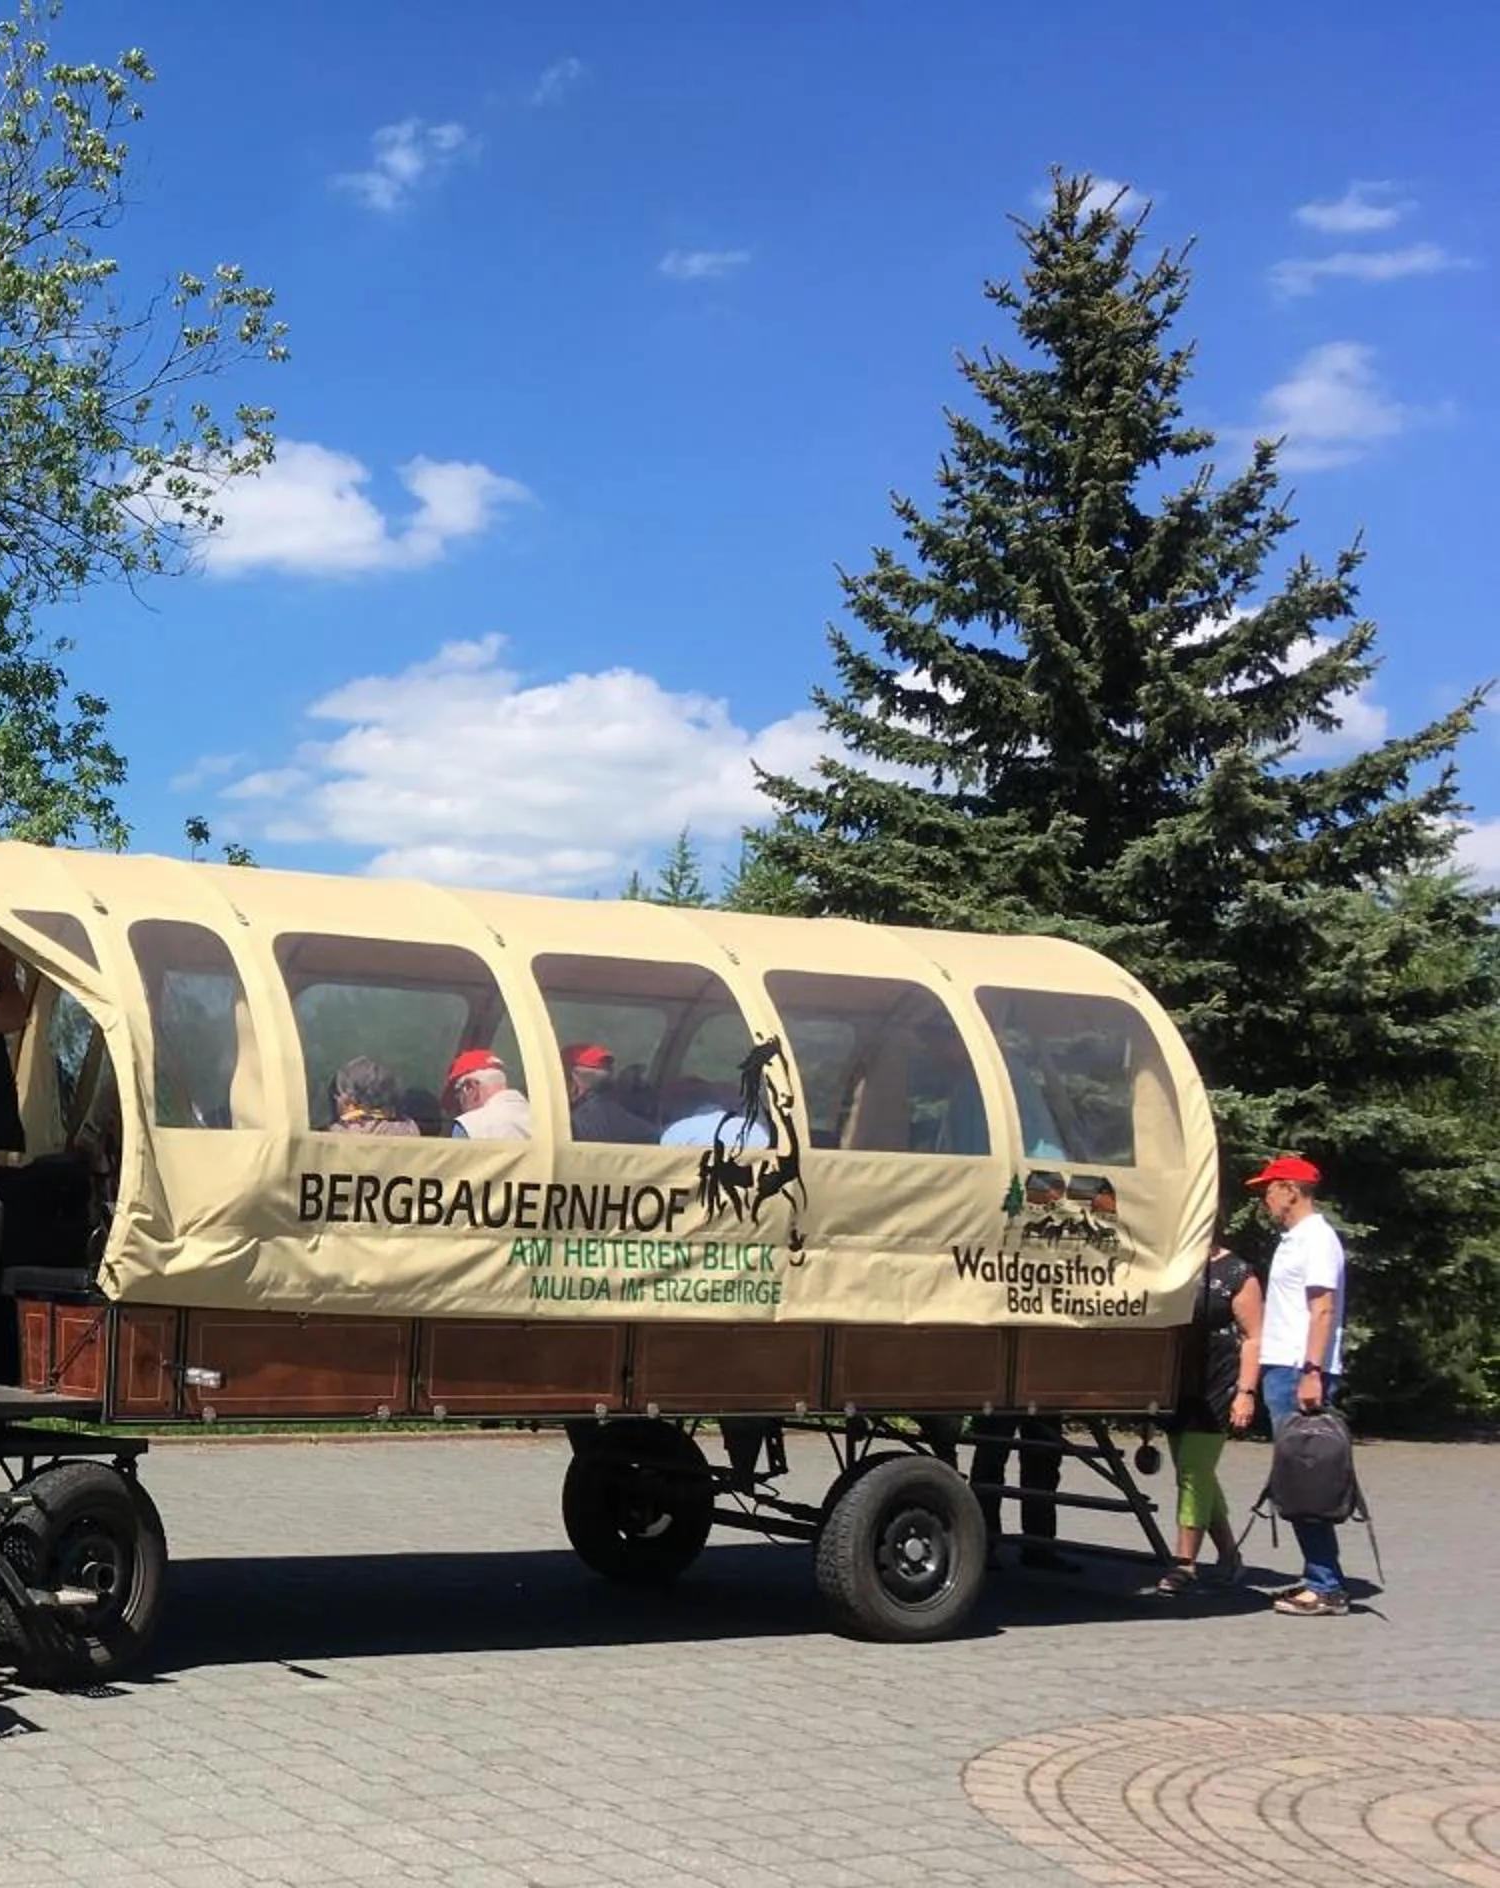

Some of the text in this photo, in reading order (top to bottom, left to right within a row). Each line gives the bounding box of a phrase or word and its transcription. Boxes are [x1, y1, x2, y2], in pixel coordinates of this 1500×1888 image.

[299, 1173, 691, 1232] BERGBAUERNHOF
[507, 1237, 775, 1272] AM HEITEREN BLICK
[952, 1245, 1117, 1293] Waldgasthof
[529, 1276, 782, 1305] MULDA IM ERZGEBIRGE
[1007, 1286, 1149, 1317] Bad Einsiedel
